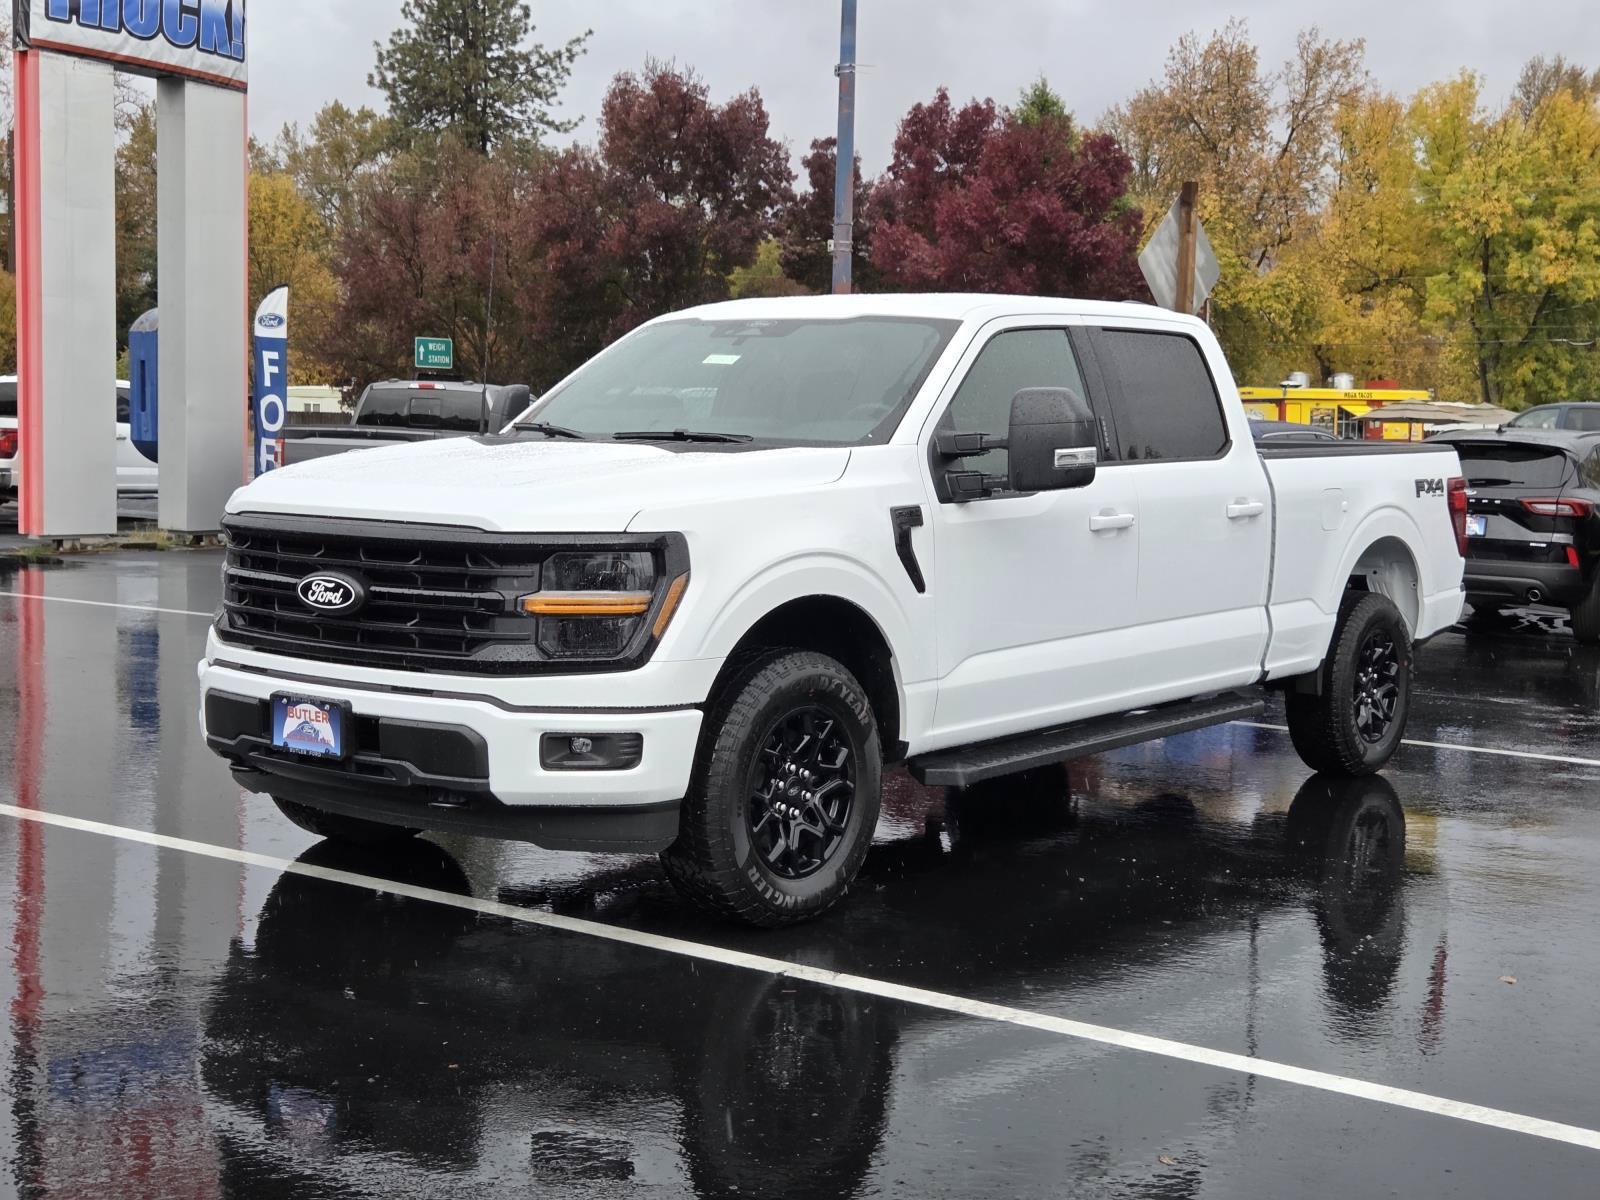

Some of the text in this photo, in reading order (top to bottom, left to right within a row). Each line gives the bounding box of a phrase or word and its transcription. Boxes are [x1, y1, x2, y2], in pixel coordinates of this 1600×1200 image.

[428, 343, 446, 351] WEIGH
[428, 355, 450, 364] STATION
[1415, 478, 1444, 498] FX4
[308, 580, 344, 605] Ford
[288, 705, 329, 724] BUTLER
